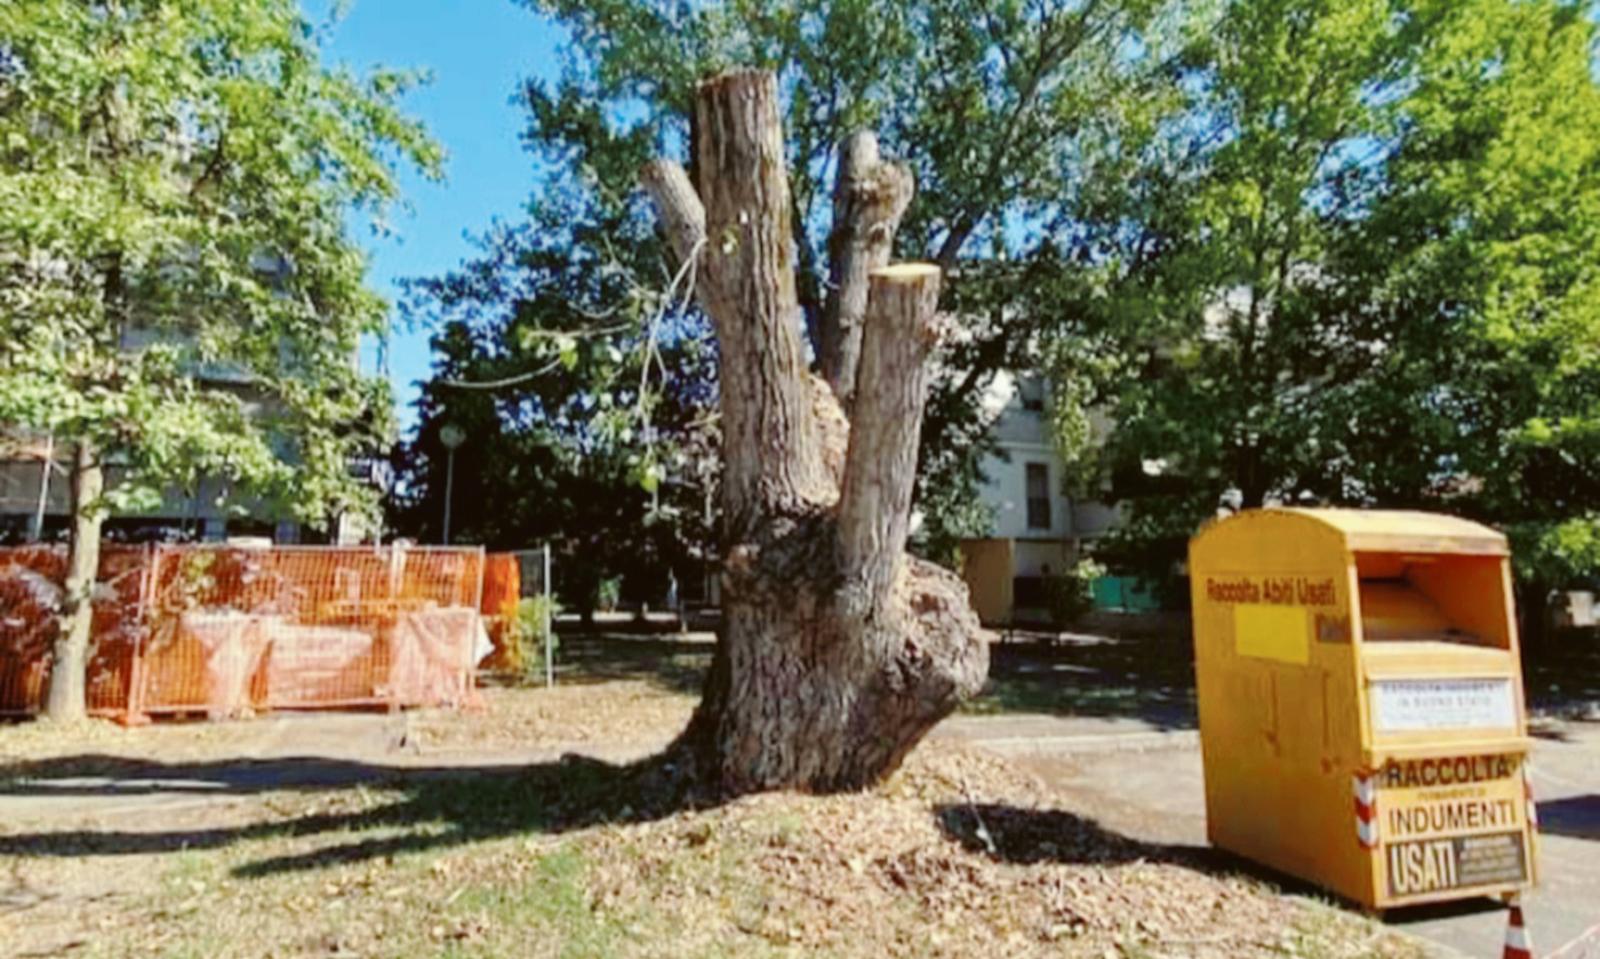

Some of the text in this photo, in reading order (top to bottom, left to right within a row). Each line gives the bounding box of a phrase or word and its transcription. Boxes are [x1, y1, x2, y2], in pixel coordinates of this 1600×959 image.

[1206, 577, 1336, 606] Raccolta Abiti Usati
[1386, 753, 1511, 788] RACCOLTA
[1388, 801, 1517, 836] INDUMENTI
[1391, 840, 1458, 894] USATI
